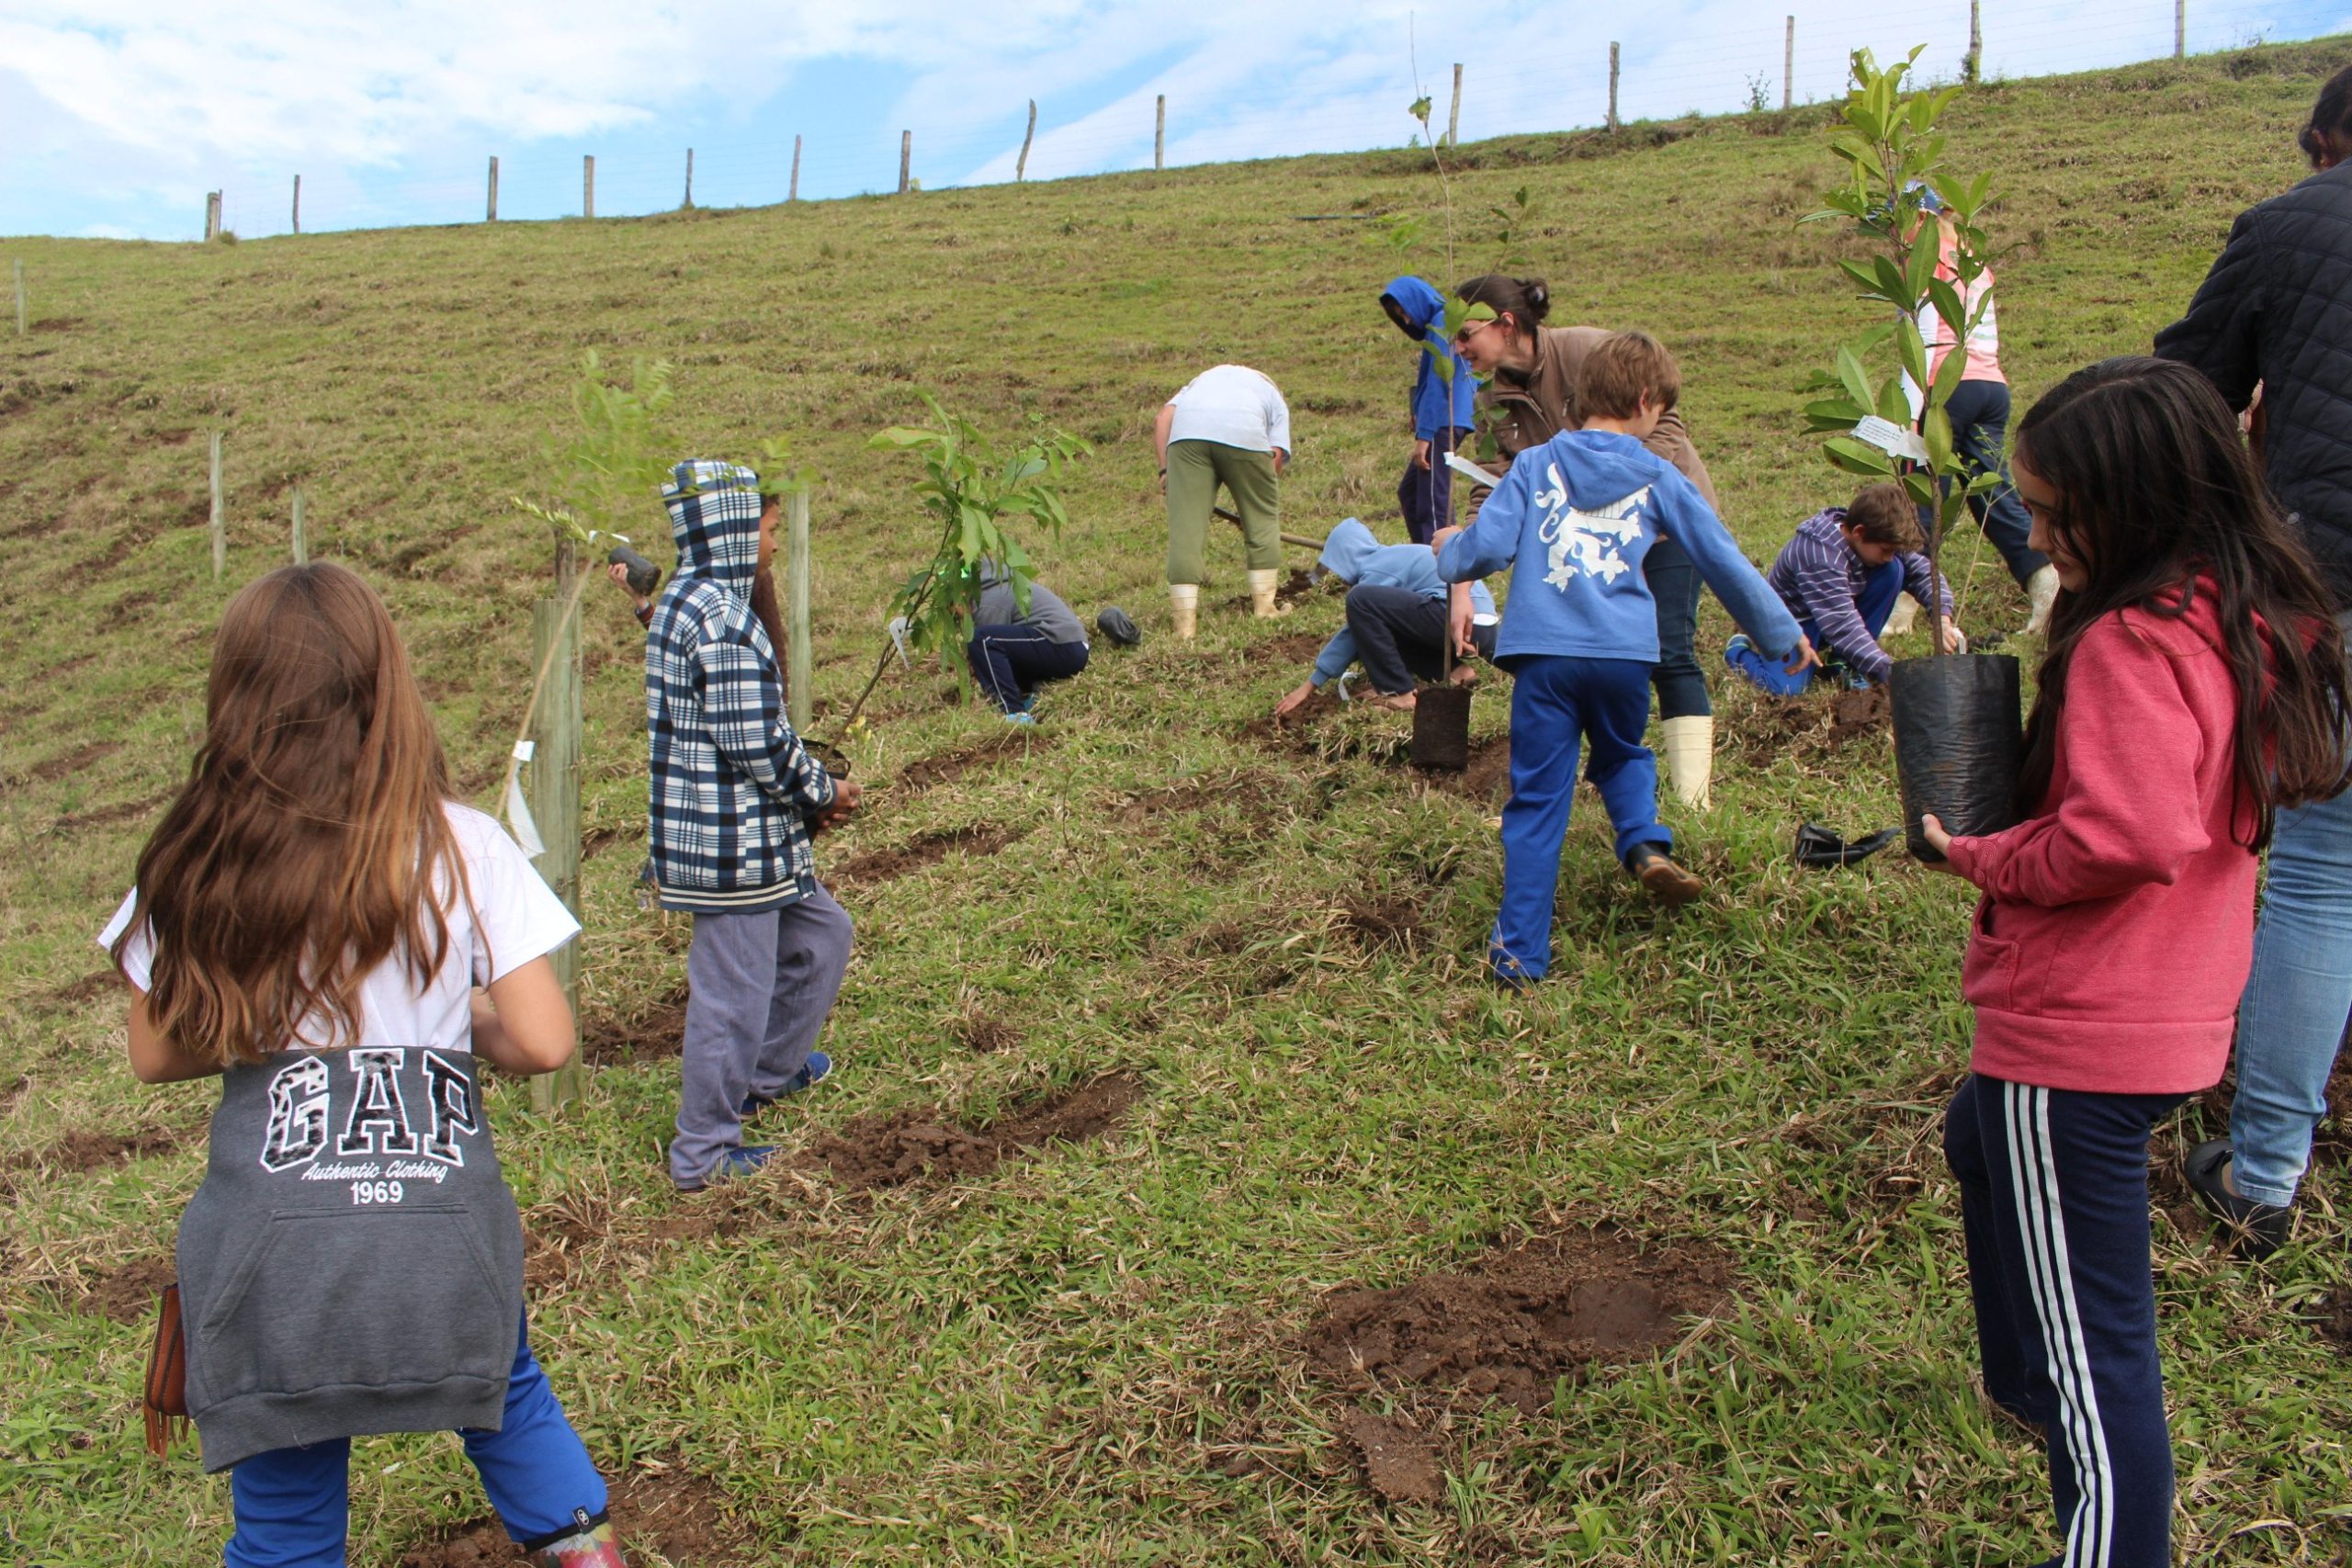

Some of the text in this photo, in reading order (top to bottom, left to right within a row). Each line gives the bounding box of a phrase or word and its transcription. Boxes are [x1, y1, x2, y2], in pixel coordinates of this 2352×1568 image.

[260, 1047, 480, 1173] GAP
[300, 1159, 449, 1184] Authentic Clothing
[349, 1180, 404, 1205] 1969
